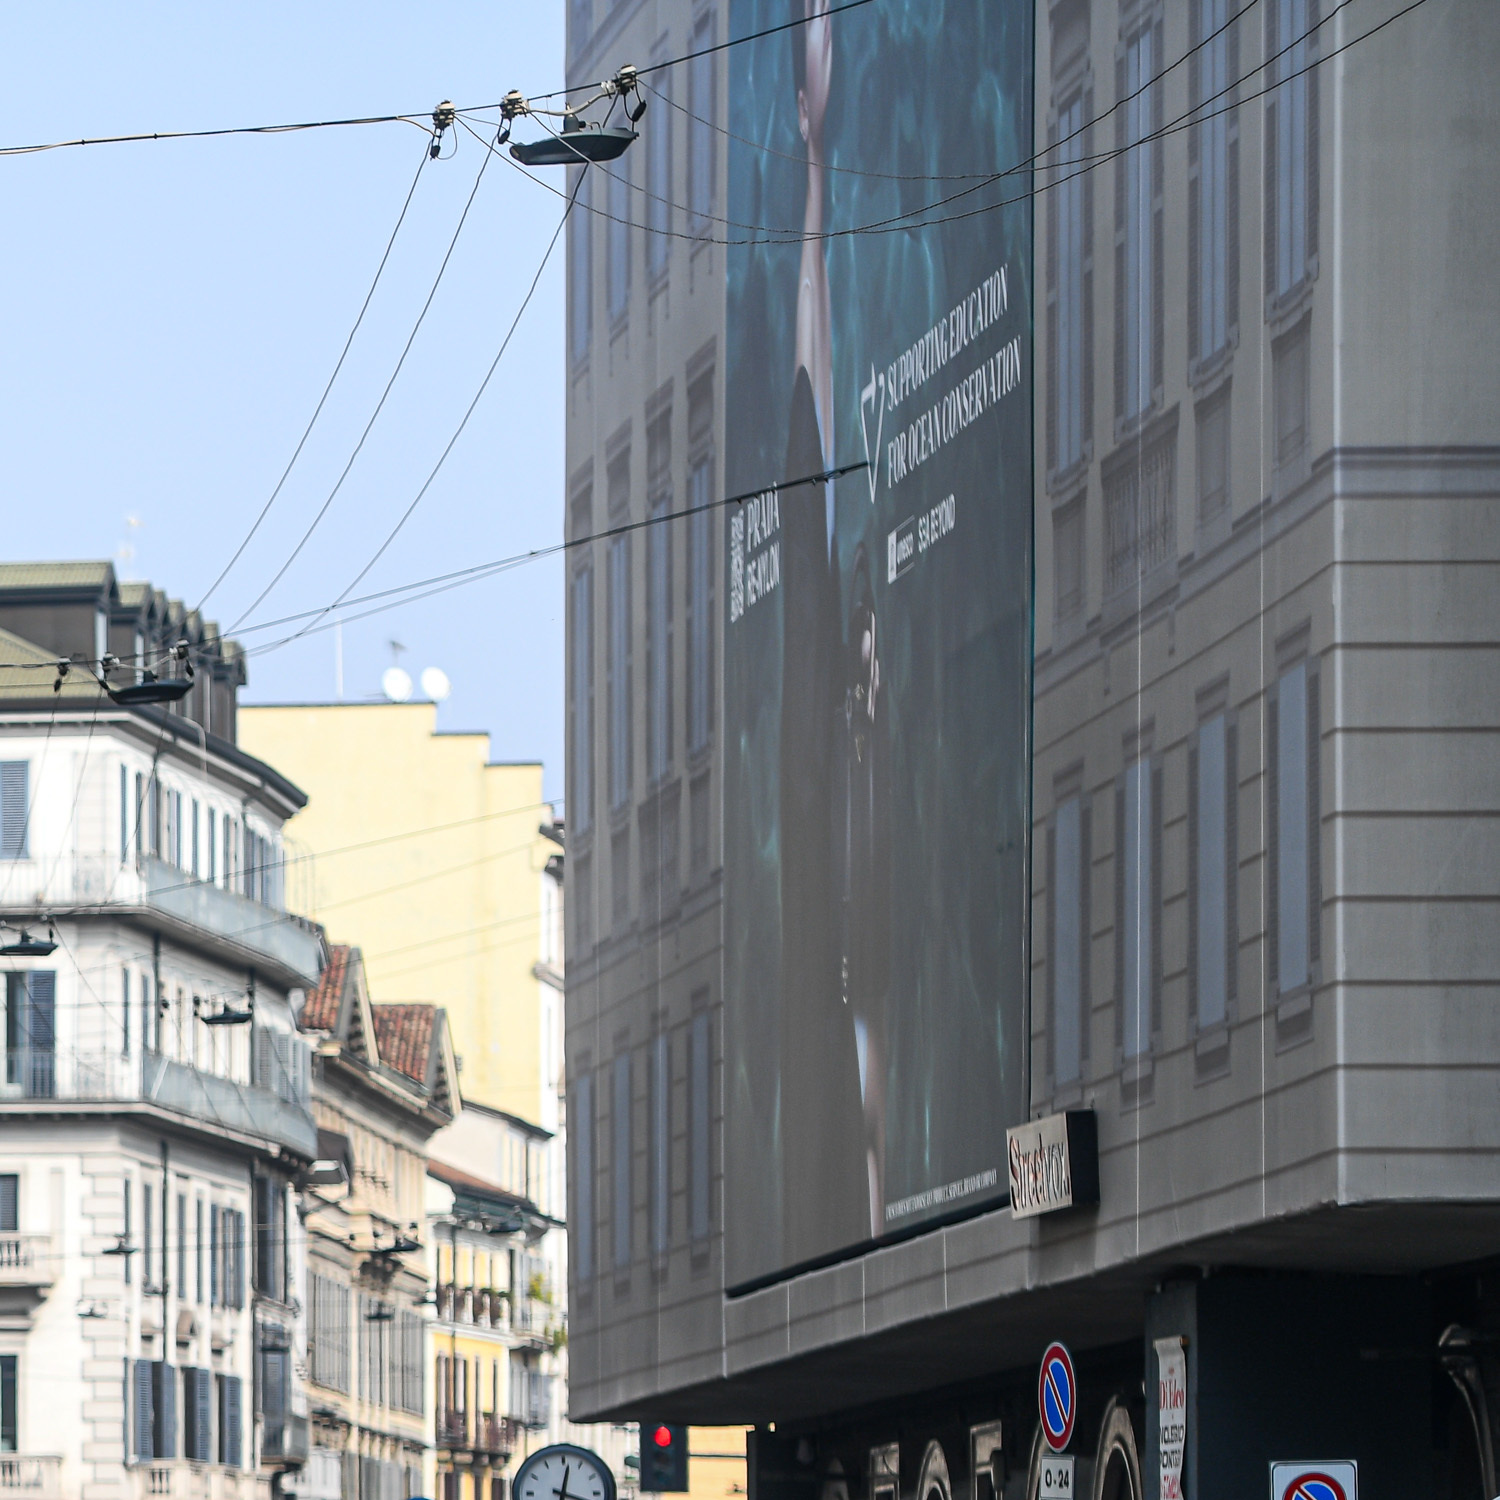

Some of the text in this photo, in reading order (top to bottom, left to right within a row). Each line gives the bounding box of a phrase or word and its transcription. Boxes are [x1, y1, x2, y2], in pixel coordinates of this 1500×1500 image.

[887, 263, 1009, 412] SUPPORTING EDUCATION
[887, 334, 1021, 489] FOR OCEAN CONSERVATION
